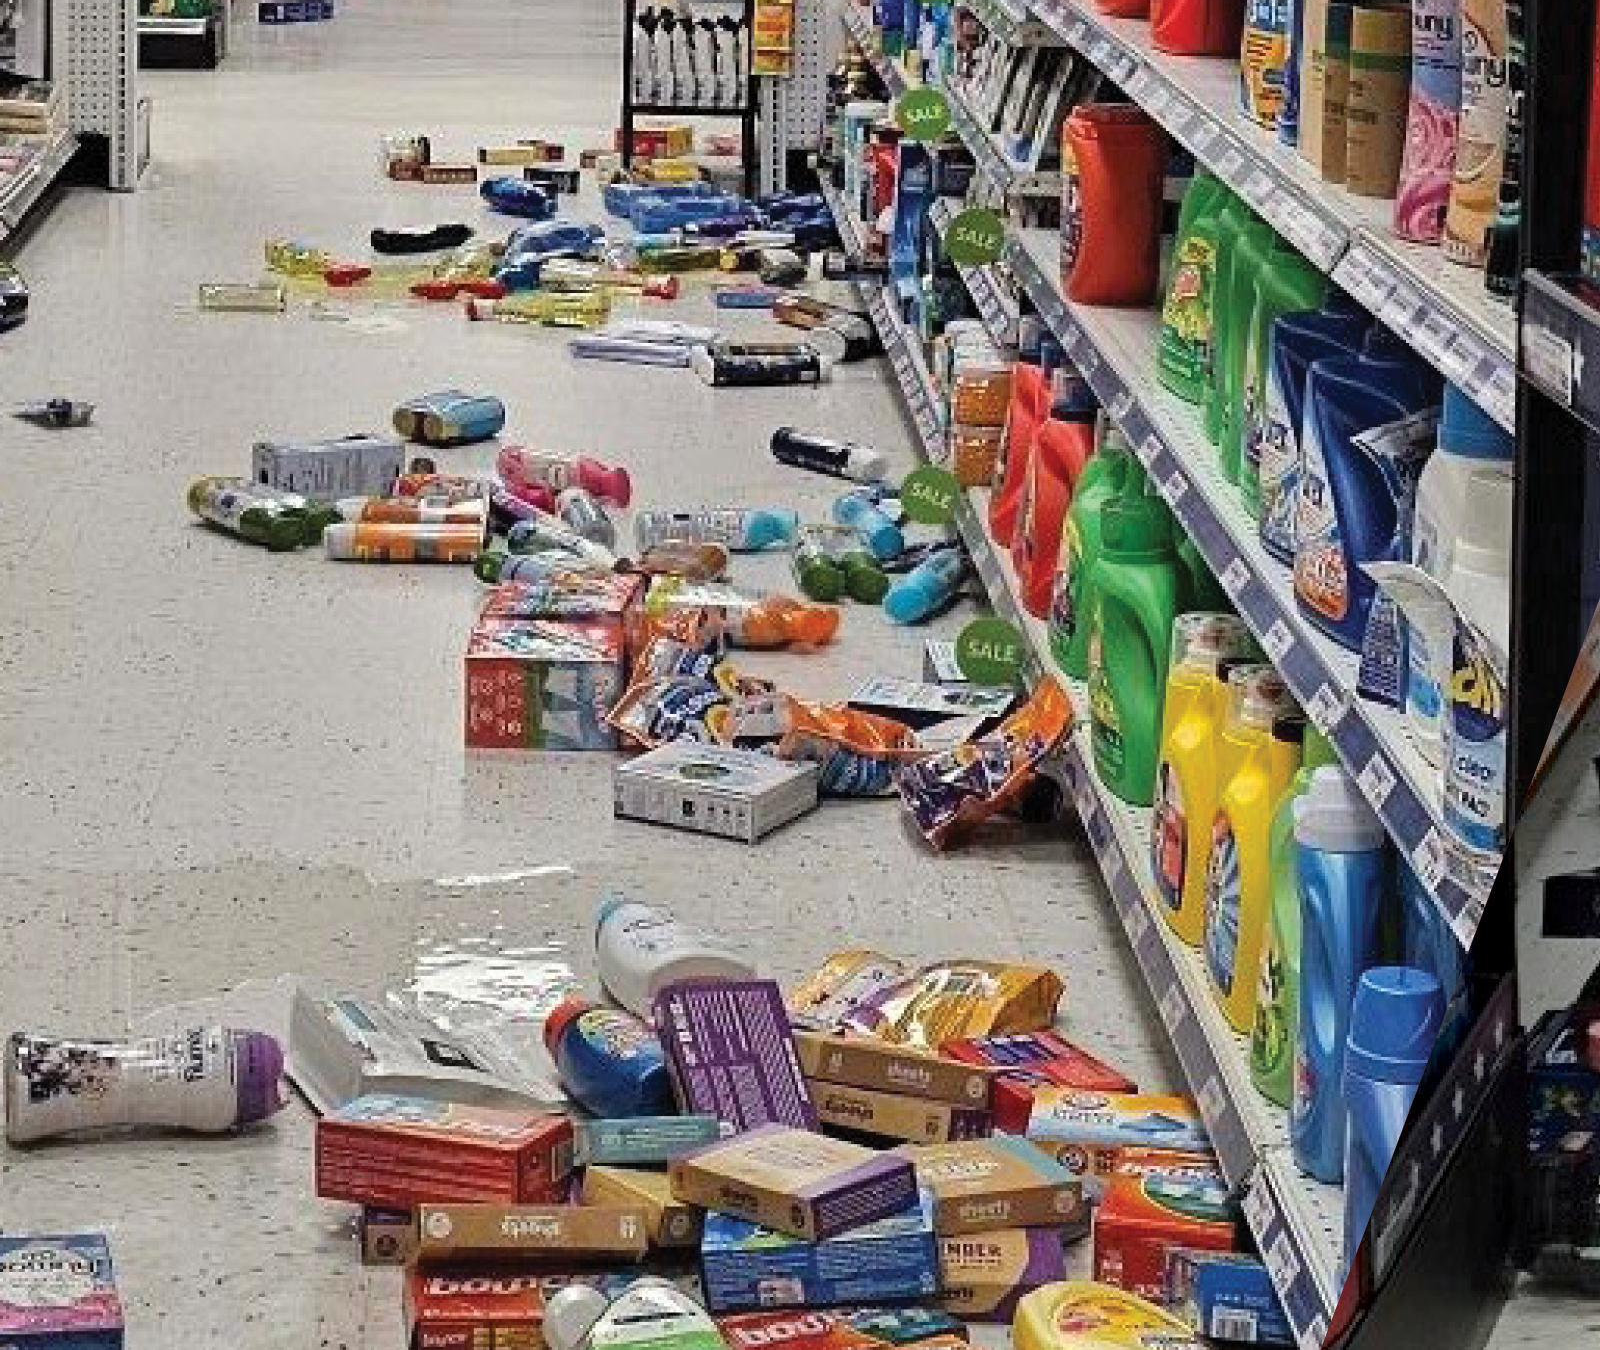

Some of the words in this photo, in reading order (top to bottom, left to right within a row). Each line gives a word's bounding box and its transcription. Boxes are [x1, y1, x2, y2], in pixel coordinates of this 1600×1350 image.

[905, 105, 943, 123] SALE
[954, 226, 998, 252] SALE
[911, 482, 952, 509] SALE
[967, 640, 1018, 664] SALE
